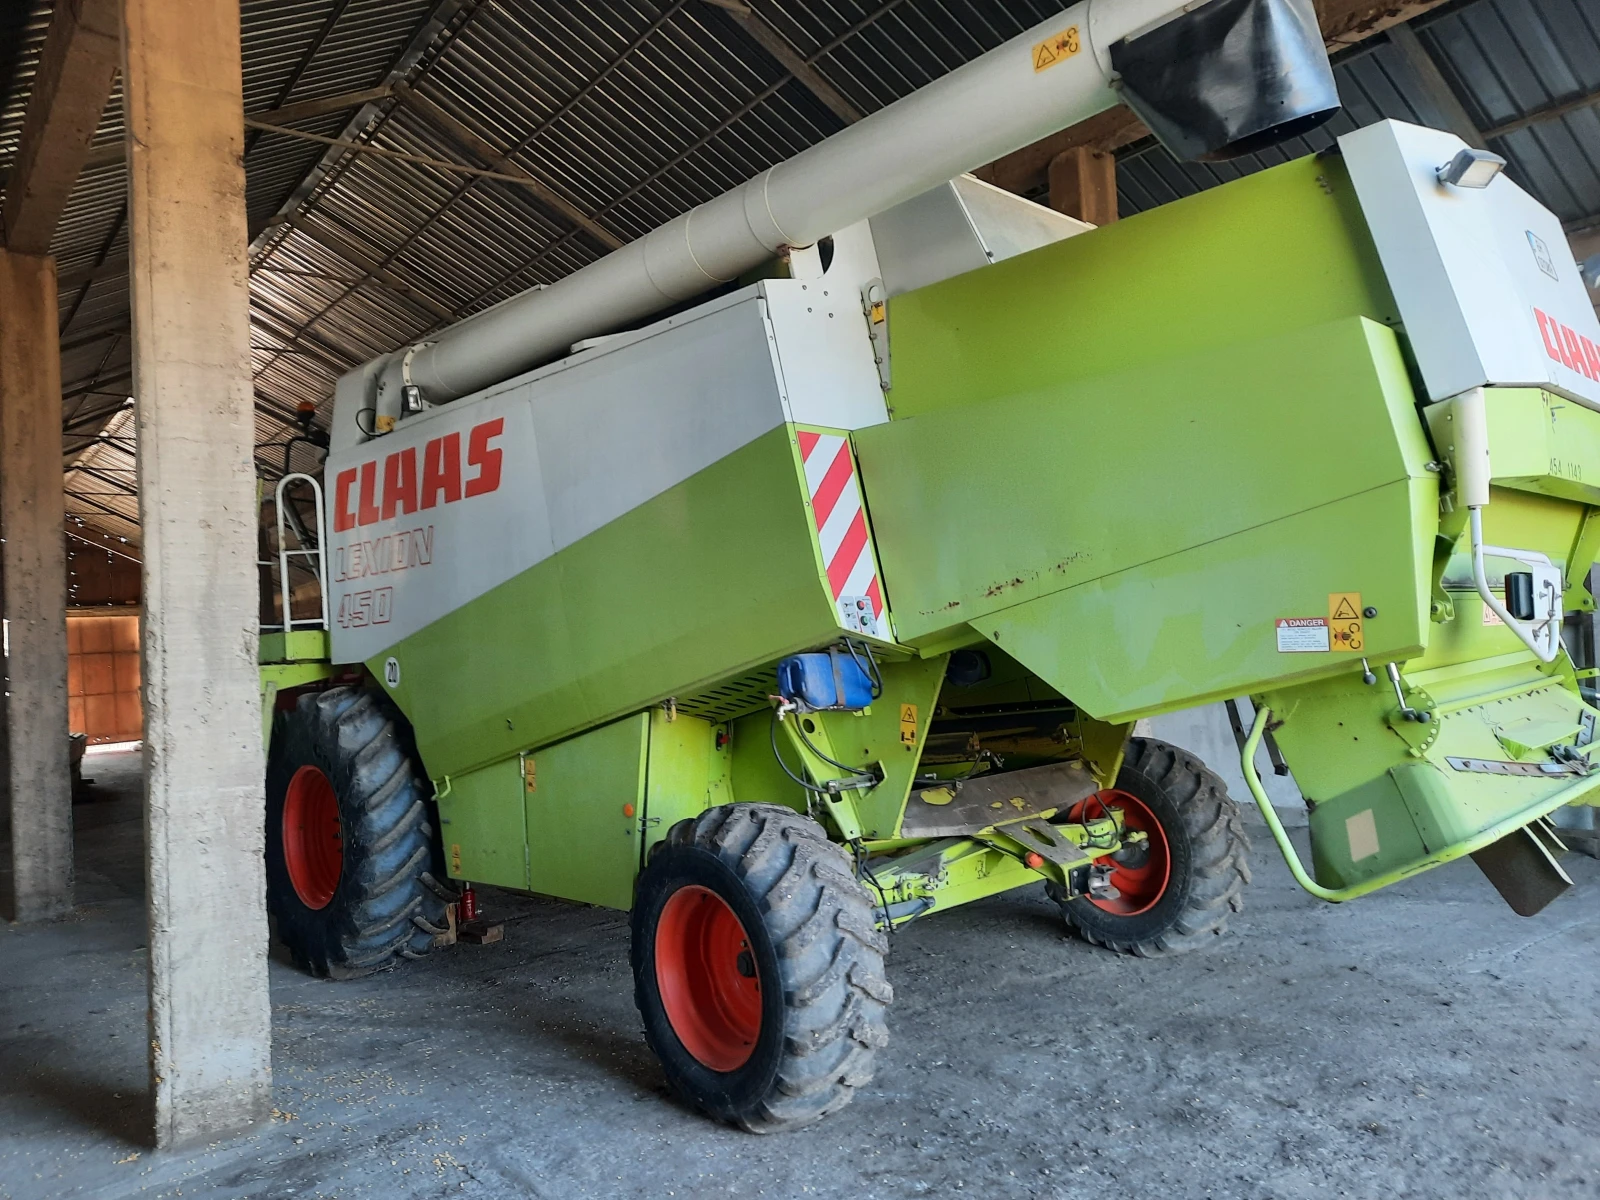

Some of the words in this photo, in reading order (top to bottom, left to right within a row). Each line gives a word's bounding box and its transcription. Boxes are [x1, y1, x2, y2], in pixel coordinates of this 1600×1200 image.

[1533, 306, 1600, 383] CLAA
[334, 417, 504, 533] CLAAS
[334, 526, 434, 582] LEXION
[337, 586, 394, 628] 450
[1289, 619, 1324, 627] DANGER
[387, 662, 398, 683] 20
